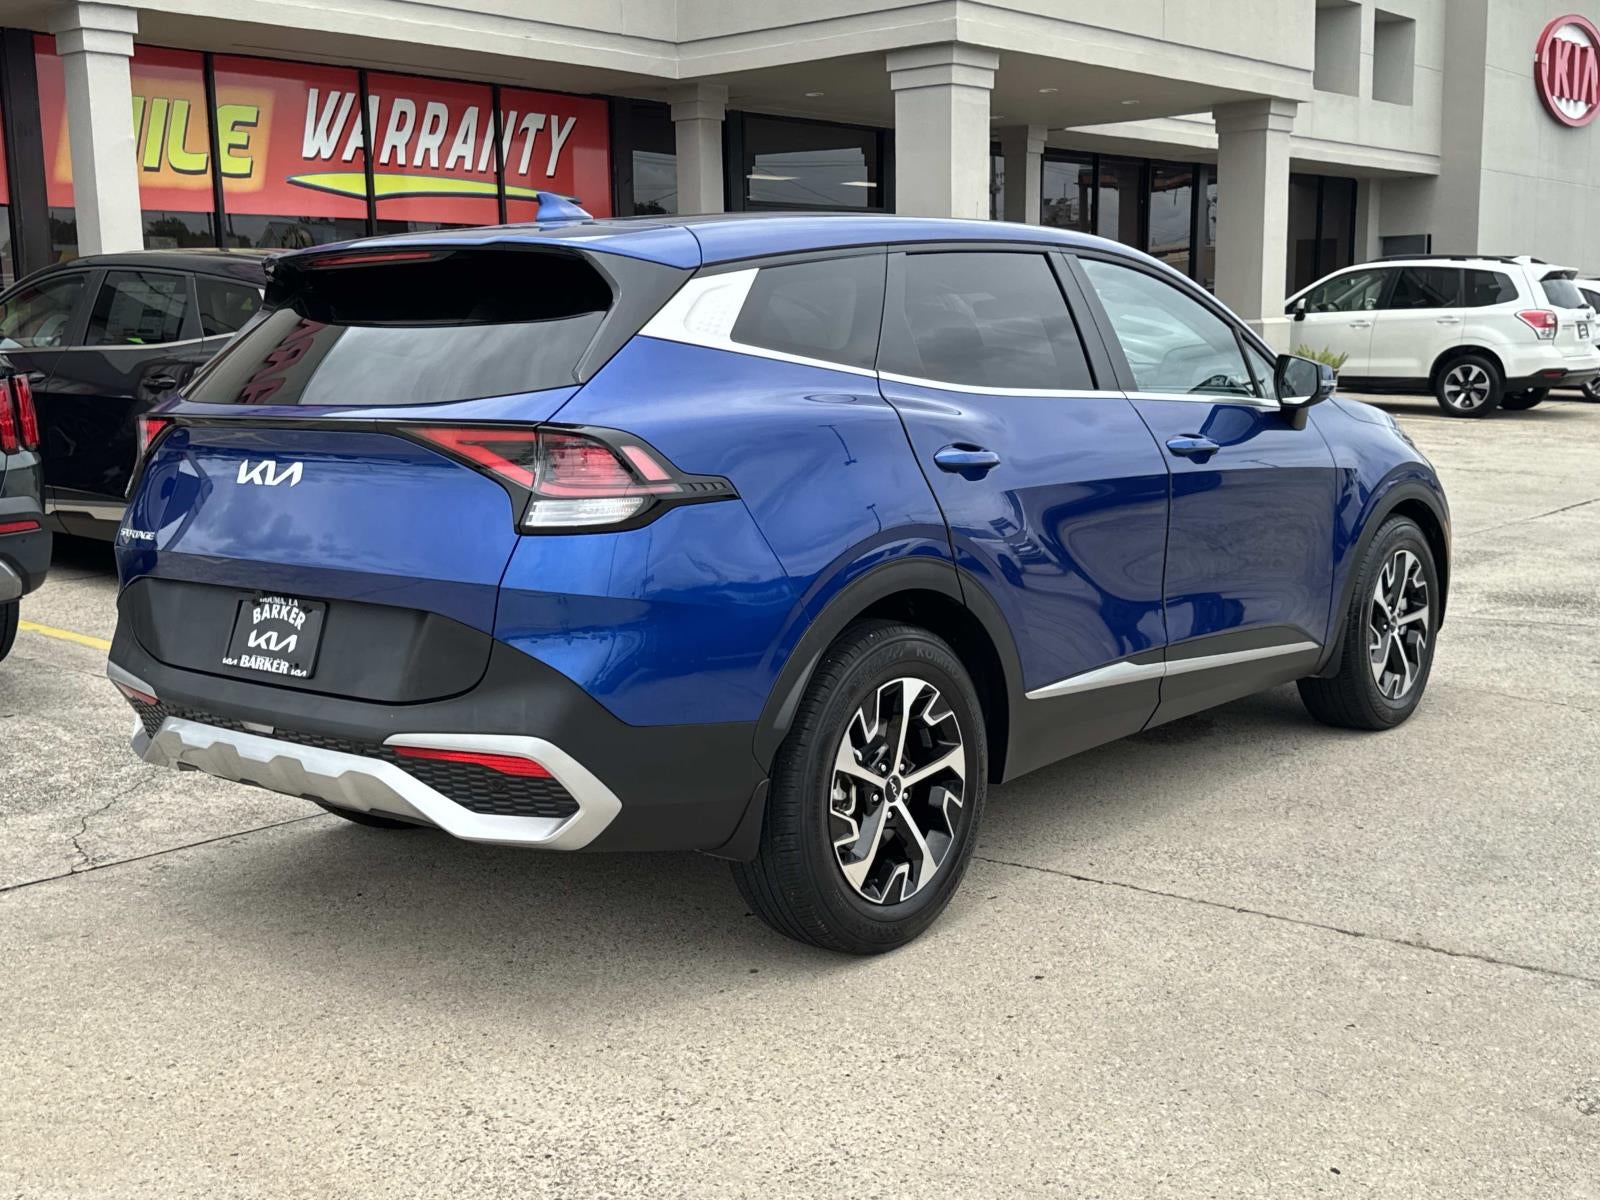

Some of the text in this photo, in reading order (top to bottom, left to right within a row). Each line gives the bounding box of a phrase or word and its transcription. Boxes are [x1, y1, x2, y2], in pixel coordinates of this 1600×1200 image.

[1551, 38, 1597, 104] KIA
[132, 88, 577, 178] ILE WARRANTY
[236, 459, 304, 487] KIA
[289, 598, 298, 606] LA
[253, 604, 306, 630] BARKER
[248, 629, 297, 653] KIA
[240, 655, 289, 674] BARKER
